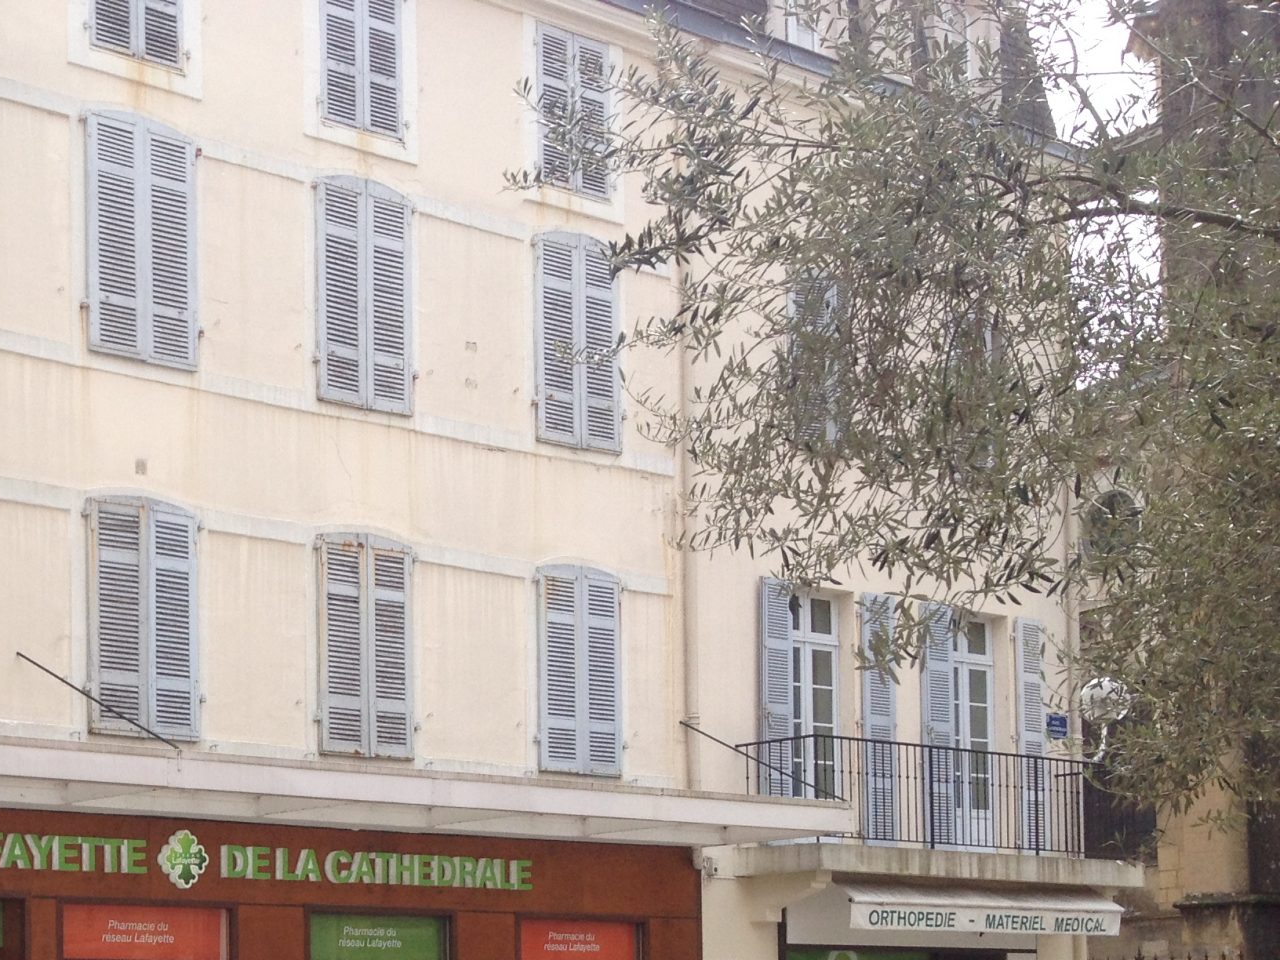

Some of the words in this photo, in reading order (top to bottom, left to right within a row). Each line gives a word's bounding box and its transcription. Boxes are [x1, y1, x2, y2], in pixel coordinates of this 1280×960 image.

[220, 844, 271, 880] DE
[275, 847, 322, 882] LA
[324, 849, 534, 891] CATHEDRALE
[107, 919, 156, 932] Pharmacie
[156, 921, 169, 932] du
[868, 909, 957, 929] ORTHOPEDIE
[985, 913, 1047, 931] MATERIEL
[1053, 916, 1107, 933] MEDICAL
[343, 925, 385, 937] Pharmacie
[386, 927, 397, 937] du
[548, 931, 585, 942] Pharmacie
[585, 931, 596, 942] du
[101, 931, 132, 943] réseau
[134, 931, 175, 945] Lafayette
[366, 938, 402, 950] Lafayette
[568, 942, 600, 953] Lafayette
